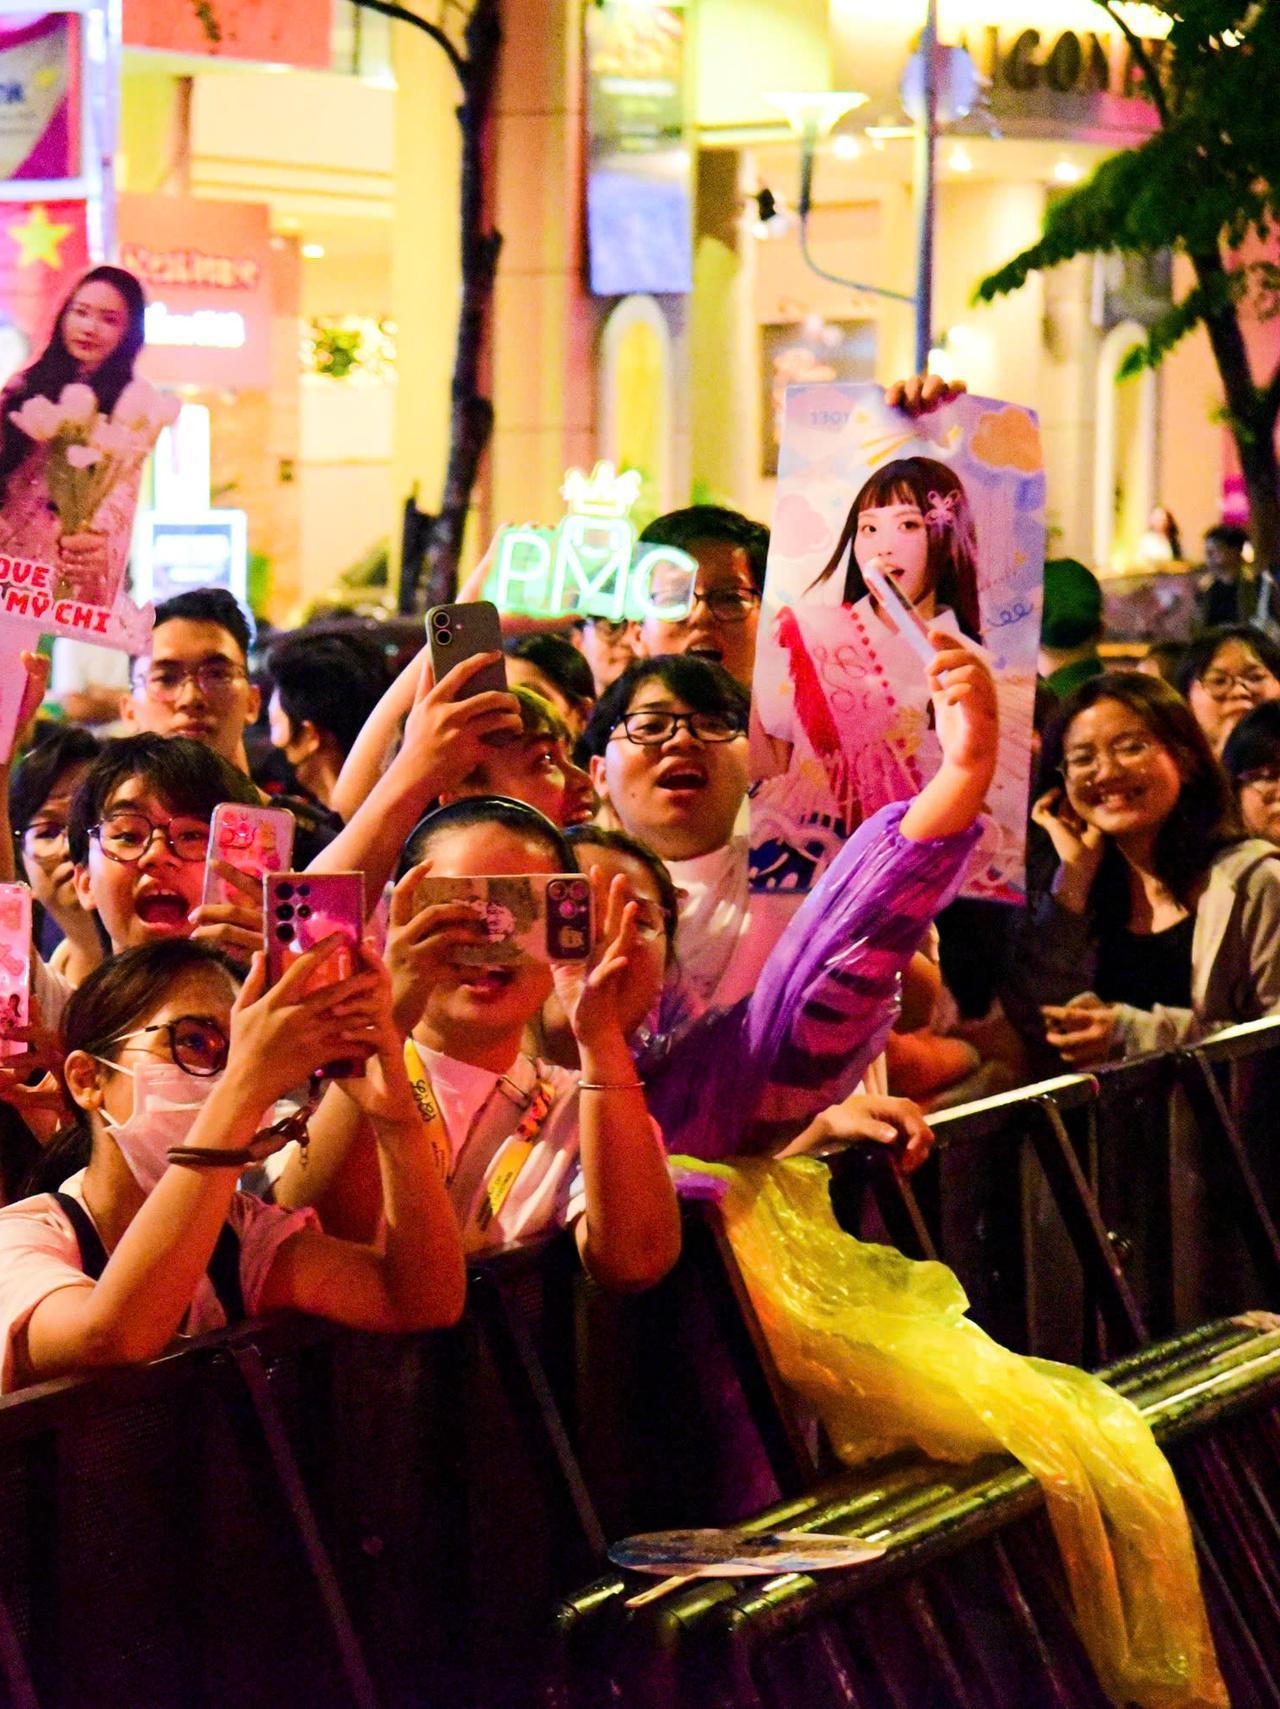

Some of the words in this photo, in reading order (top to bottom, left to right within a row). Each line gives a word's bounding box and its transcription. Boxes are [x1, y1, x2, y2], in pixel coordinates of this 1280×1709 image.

[496, 514, 699, 623] PMC
[5, 590, 50, 619] MỸ
[55, 602, 111, 634] CHI
